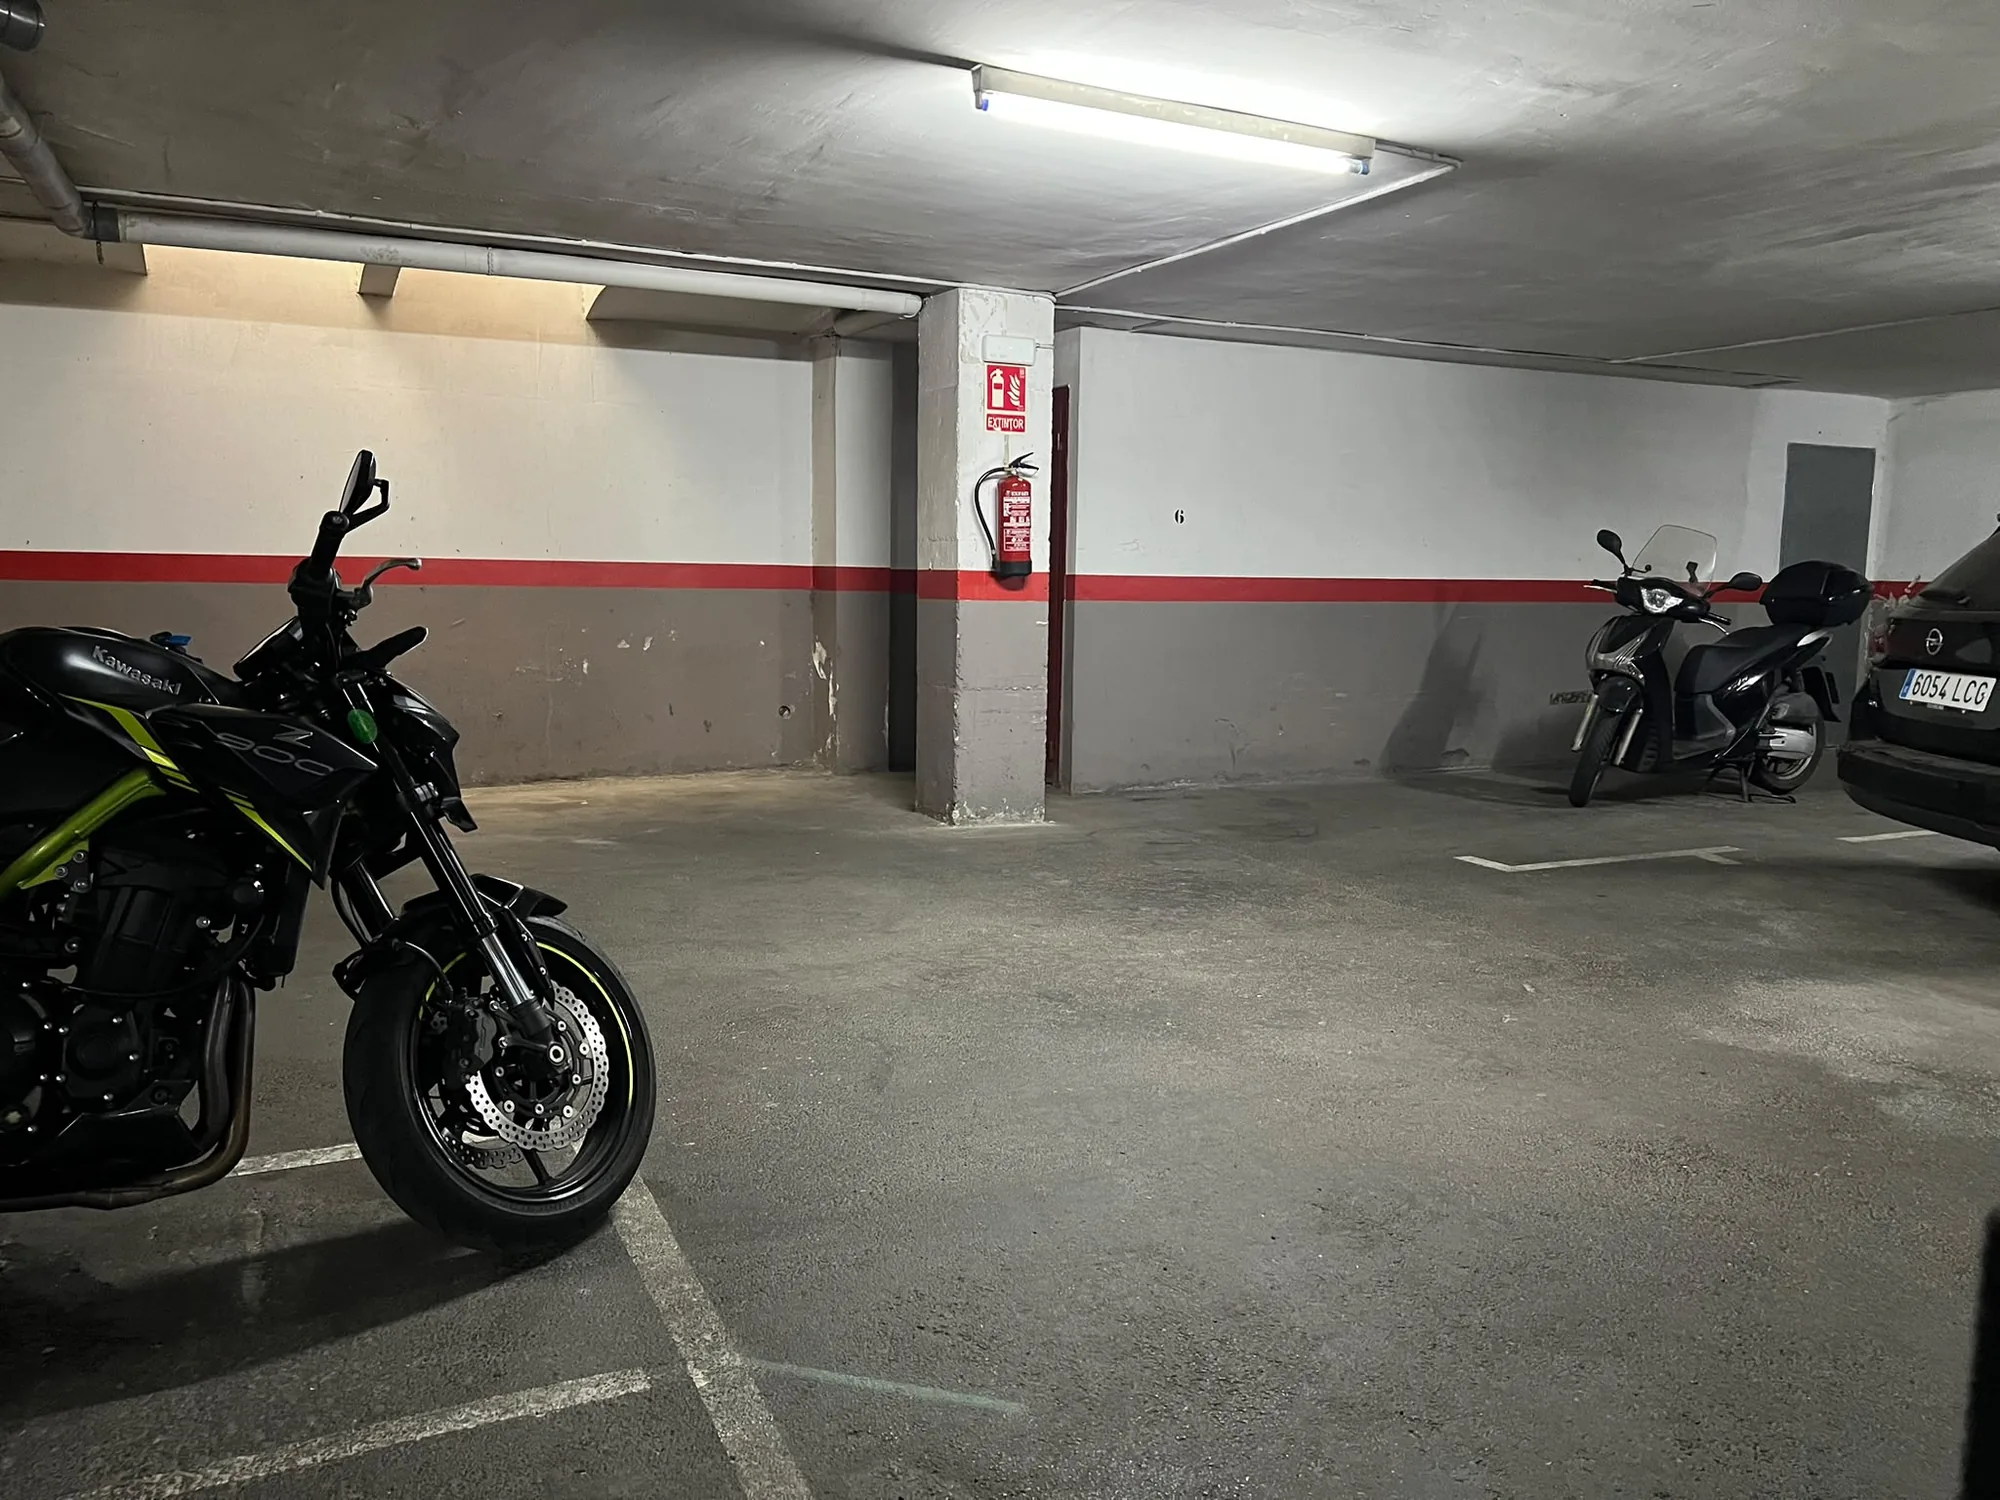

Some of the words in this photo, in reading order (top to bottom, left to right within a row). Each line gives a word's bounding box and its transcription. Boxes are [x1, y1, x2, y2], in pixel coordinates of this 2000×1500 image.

[987, 416, 1024, 431] EXTINTOR
[1174, 509, 1185, 524] 6
[92, 645, 183, 696] Kawasaki
[1912, 673, 1951, 700] 6054
[1951, 677, 1988, 705] LCG
[215, 732, 335, 777] 900
